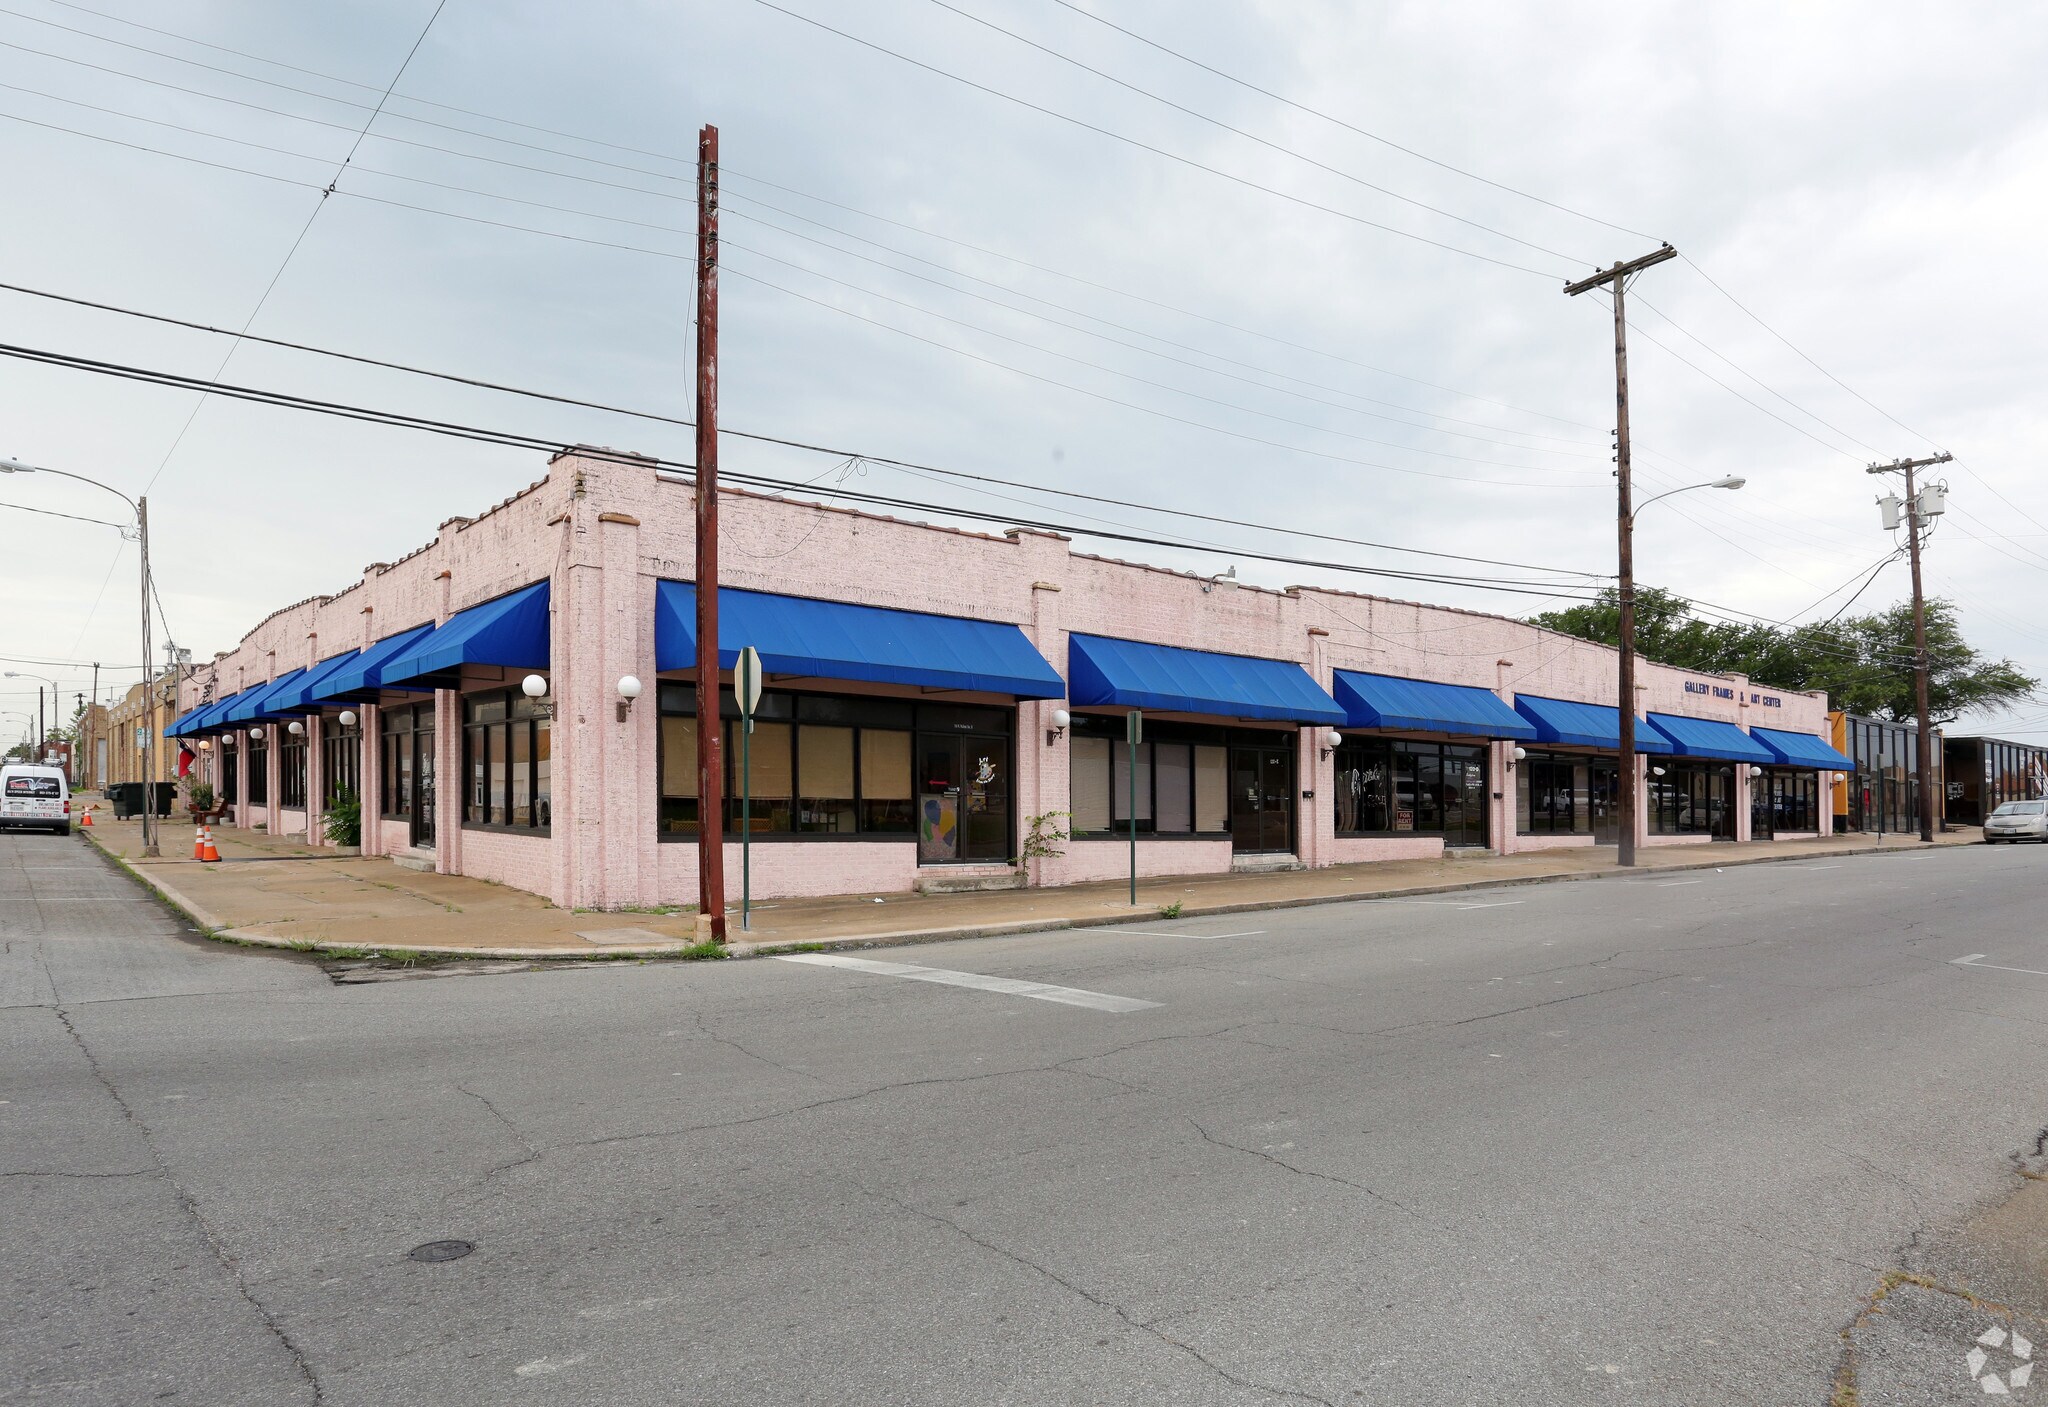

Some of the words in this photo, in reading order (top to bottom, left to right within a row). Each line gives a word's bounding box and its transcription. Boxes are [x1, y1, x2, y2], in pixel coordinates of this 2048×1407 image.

[1685, 681, 1710, 696] GALLERY
[1713, 686, 1734, 701] FRAMES
[1740, 691, 1744, 702] &
[1751, 693, 1761, 705] ART
[1763, 696, 1781, 708] CENTER
